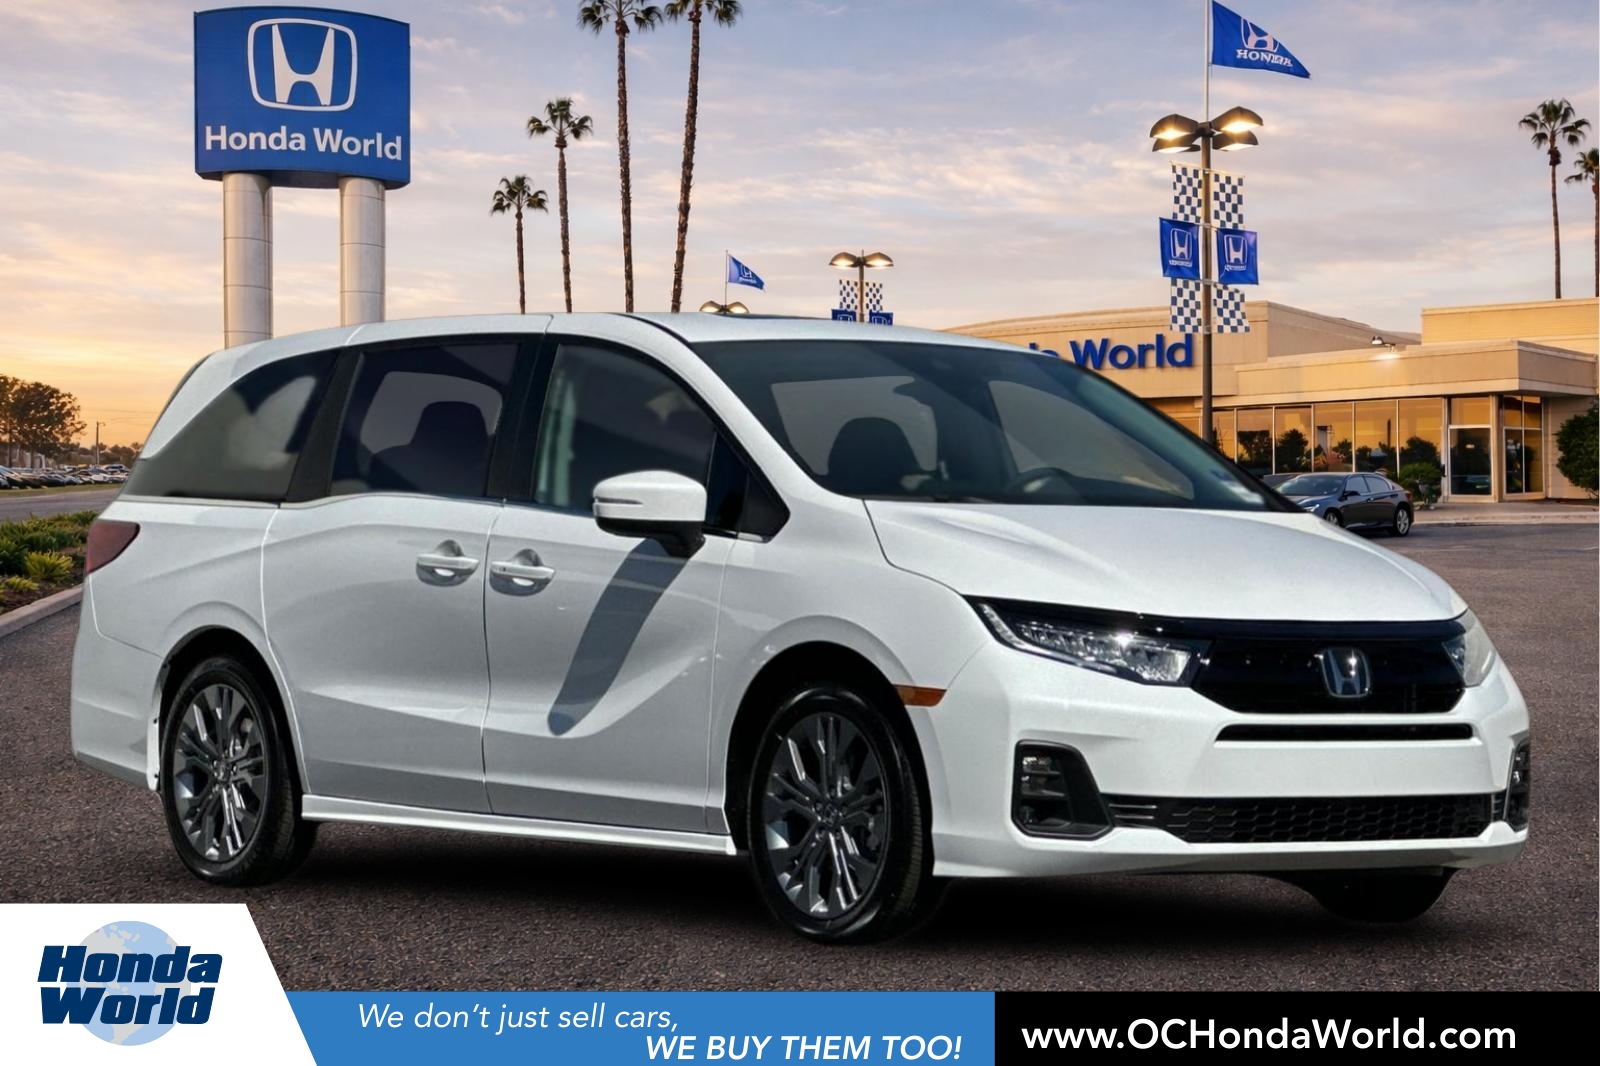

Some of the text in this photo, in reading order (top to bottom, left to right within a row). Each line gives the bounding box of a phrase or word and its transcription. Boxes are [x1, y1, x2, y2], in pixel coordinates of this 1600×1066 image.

[205, 125, 402, 160] Honda World
[1070, 333, 1193, 370] World
